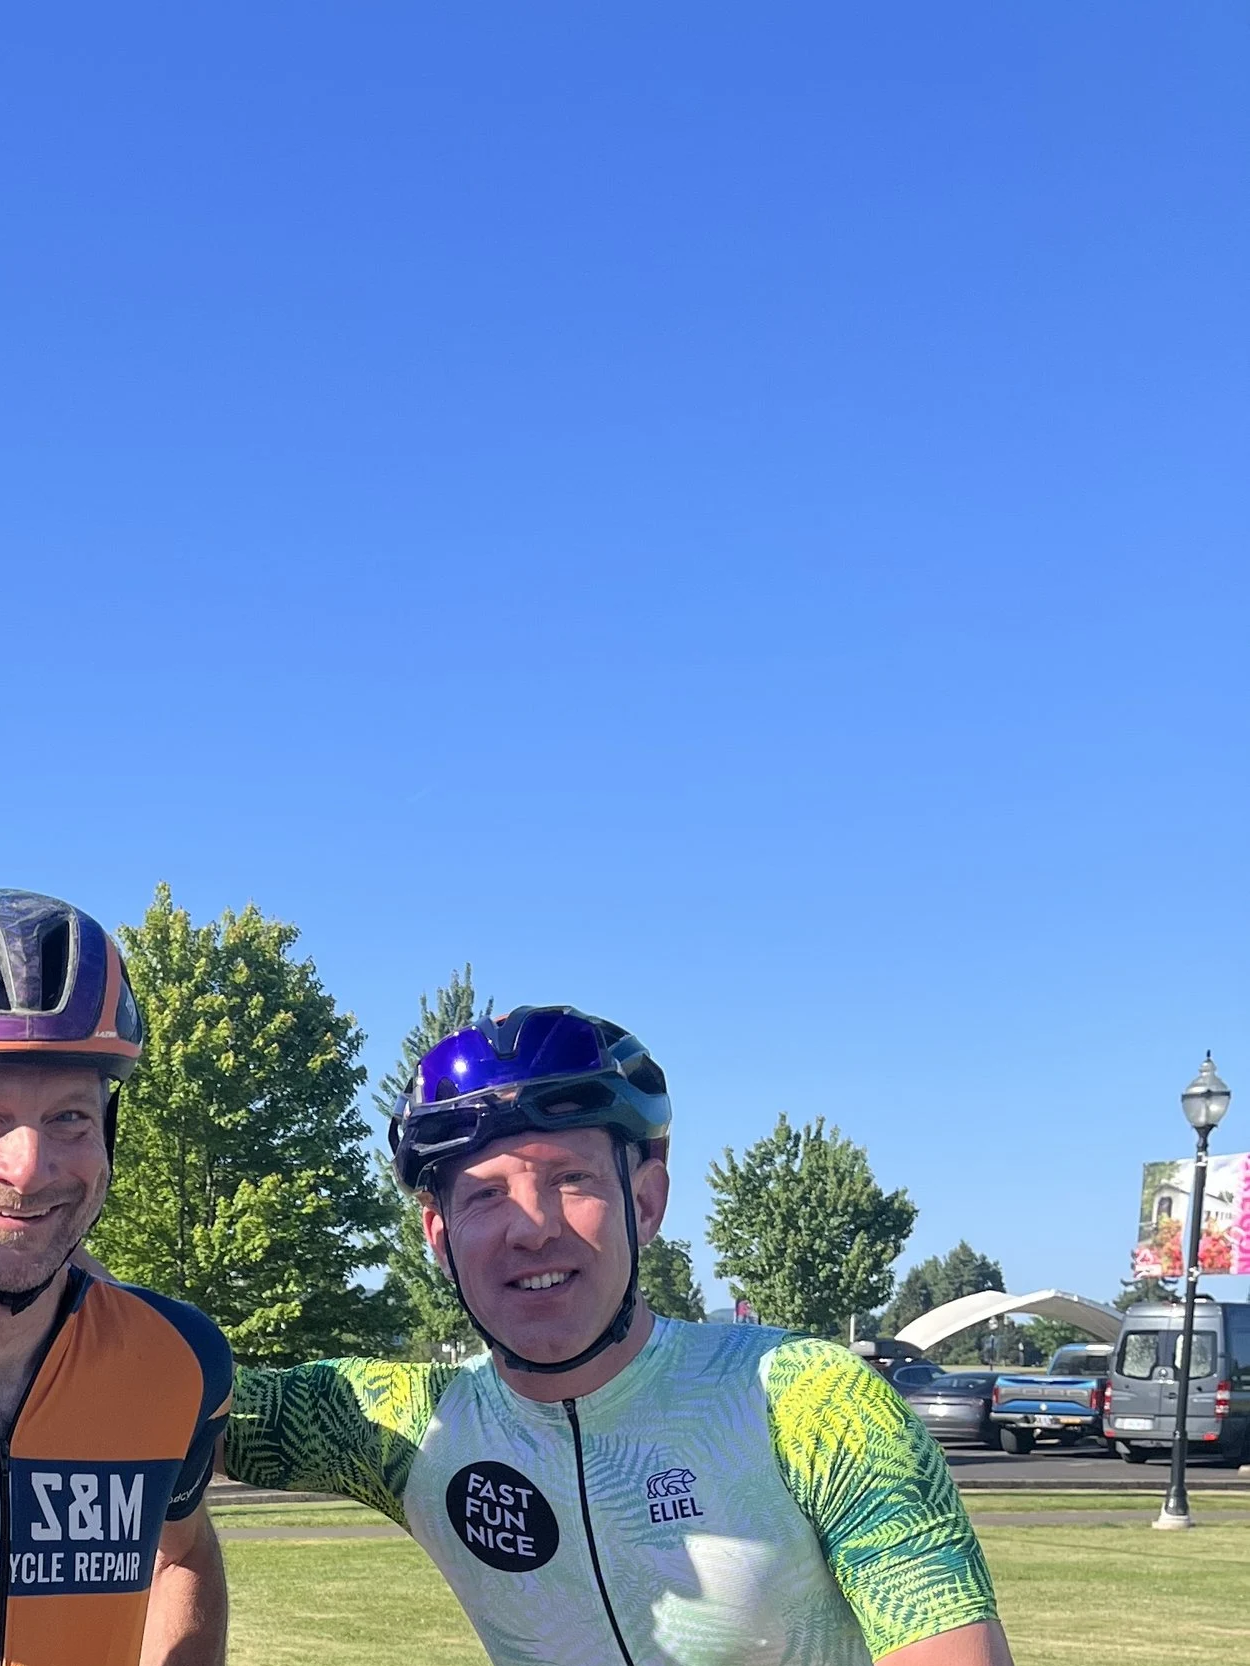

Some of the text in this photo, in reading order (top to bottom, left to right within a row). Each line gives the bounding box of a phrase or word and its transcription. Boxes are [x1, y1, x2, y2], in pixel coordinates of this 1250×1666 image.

[30, 1471, 145, 1541] S&M
[467, 1472, 533, 1509] FAST
[466, 1496, 526, 1532] FUN
[651, 1497, 704, 1524] ELIEL
[466, 1520, 537, 1557] NICE
[74, 1551, 141, 1582] REPAIR
